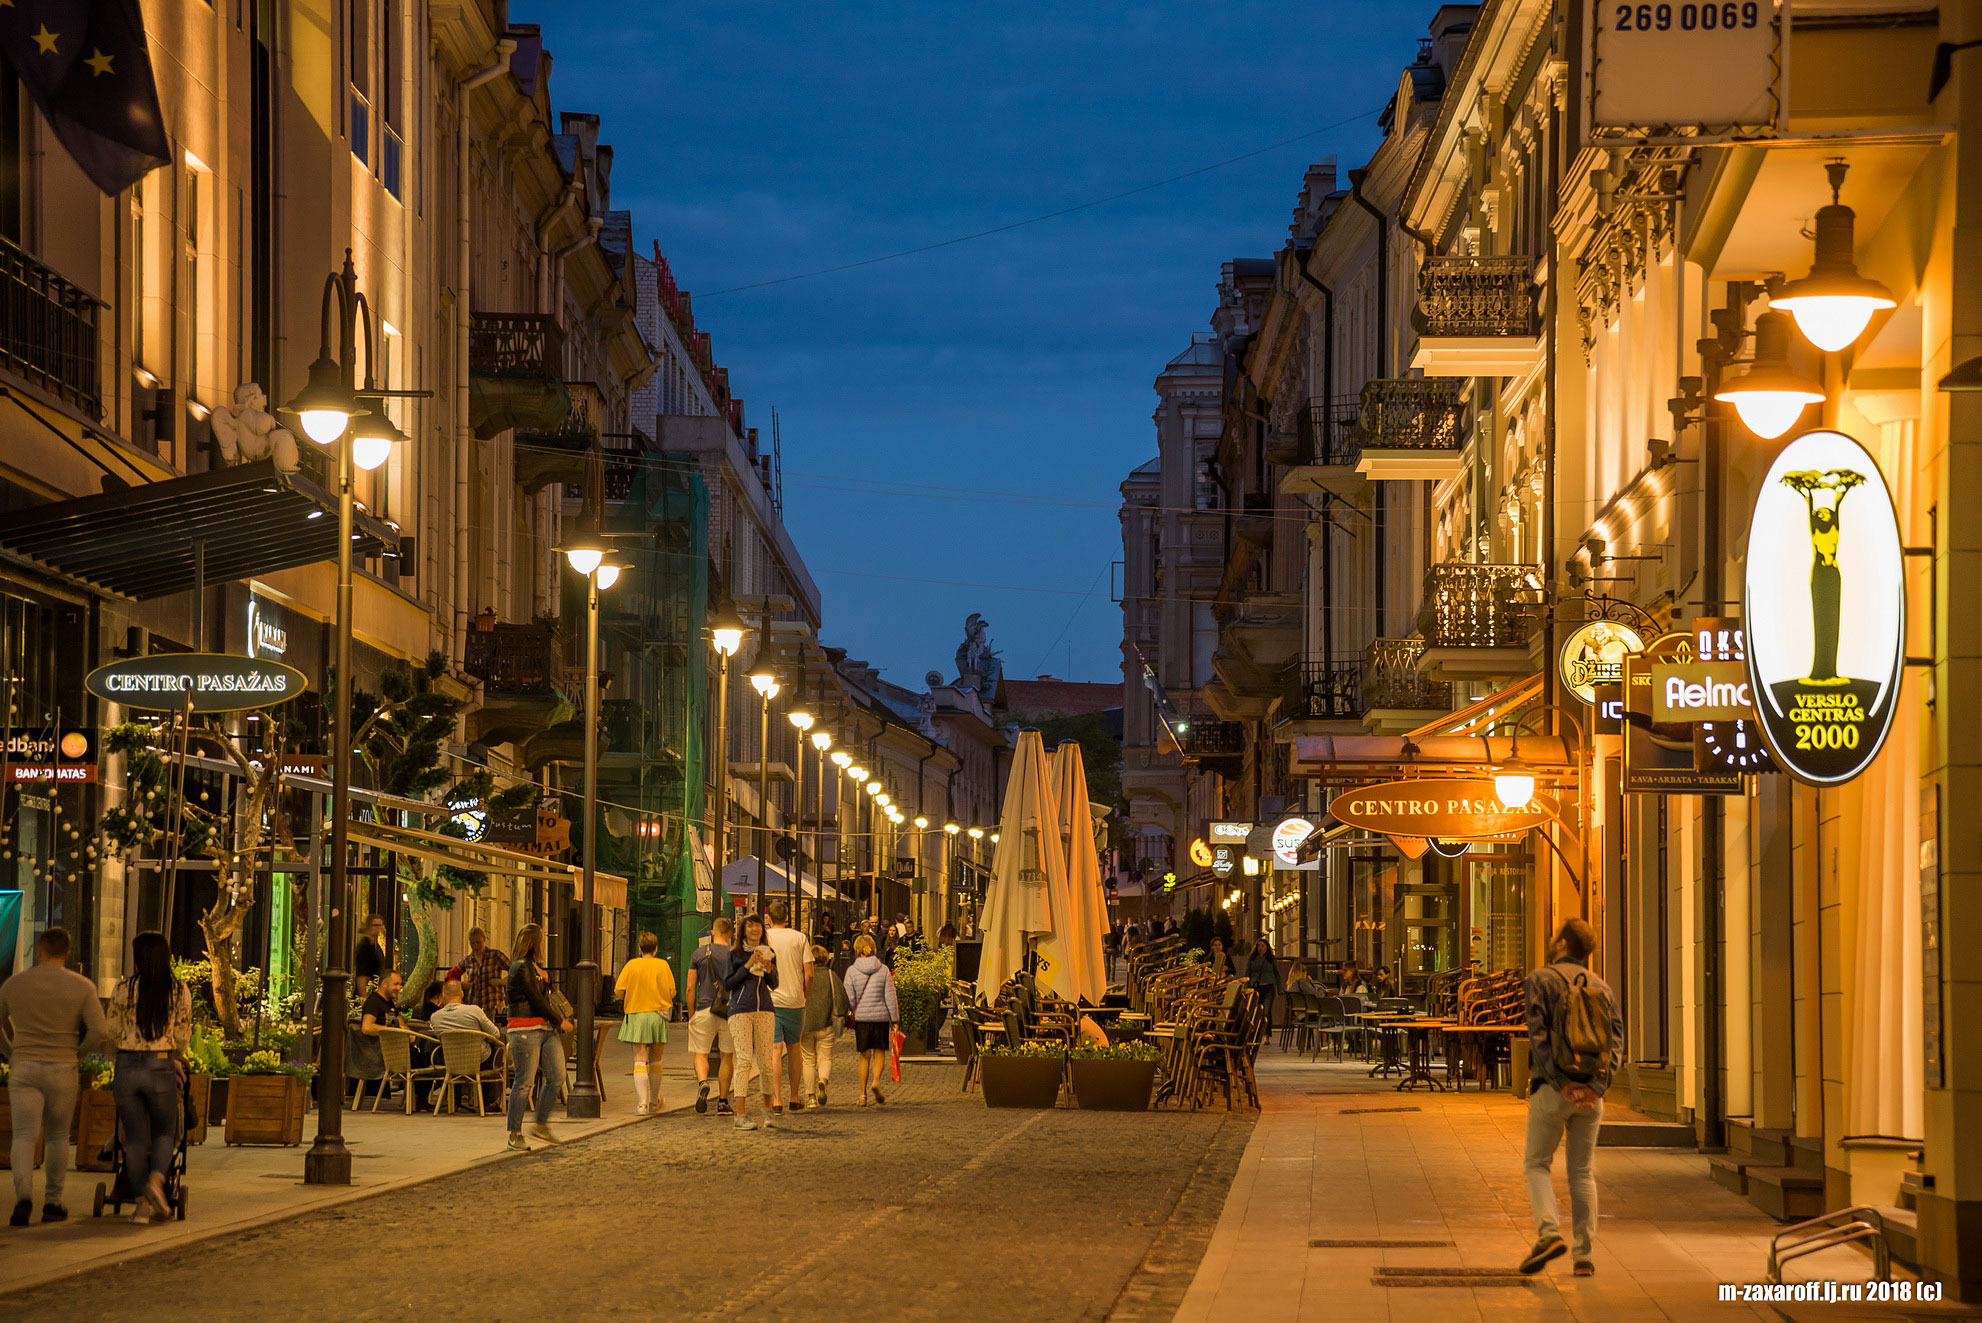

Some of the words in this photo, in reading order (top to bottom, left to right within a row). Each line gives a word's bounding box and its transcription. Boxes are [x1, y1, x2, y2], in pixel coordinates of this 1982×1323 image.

[1615, 4, 1671, 31] 269
[1681, 2, 1757, 31] 0069
[105, 674, 193, 692] CENTRO
[197, 670, 287, 692] PASAŽAS
[1794, 693, 1859, 708] VERSLO
[1789, 707, 1865, 722] CENTRAS
[1795, 724, 1859, 751] 2000
[15, 768, 86, 779] BANOMATAS
[1697, 776, 1738, 784] TABAKAS
[1349, 800, 1439, 816] CENTRO
